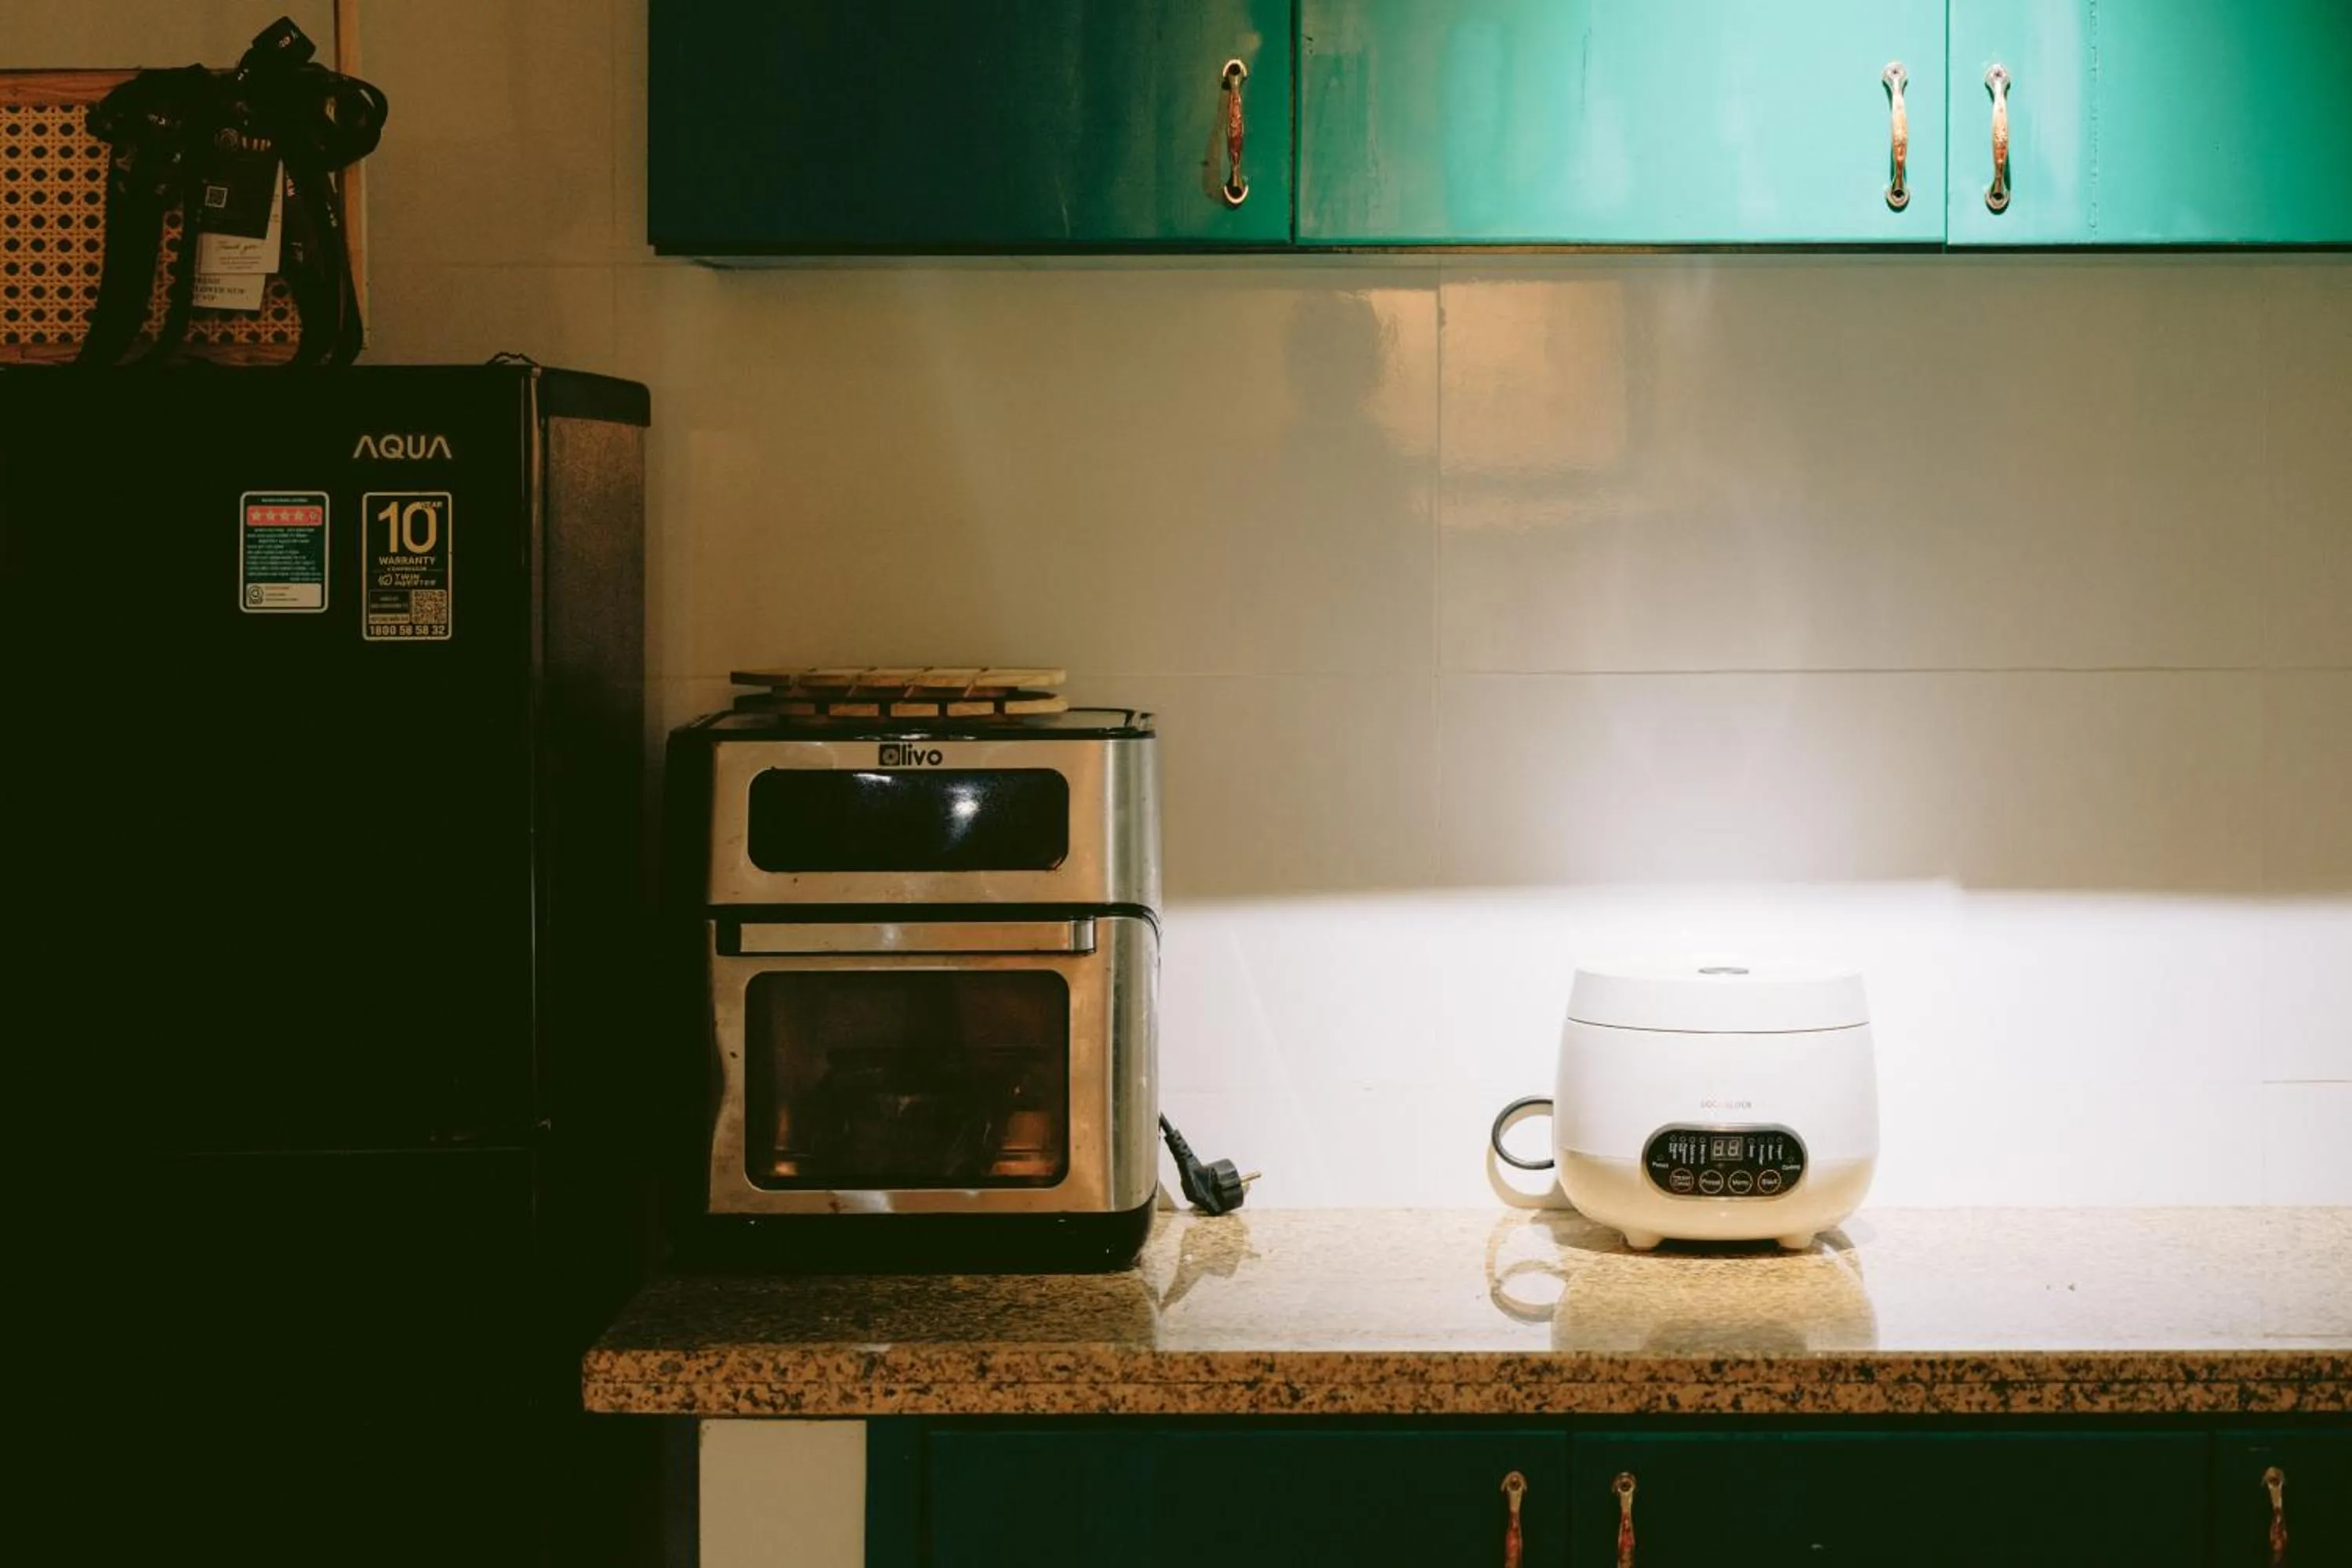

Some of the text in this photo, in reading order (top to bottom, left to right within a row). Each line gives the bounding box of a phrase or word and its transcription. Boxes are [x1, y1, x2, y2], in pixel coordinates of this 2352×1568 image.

[352, 434, 452, 459] AQUA
[377, 501, 437, 554] 10
[379, 556, 435, 564] WARRANTY
